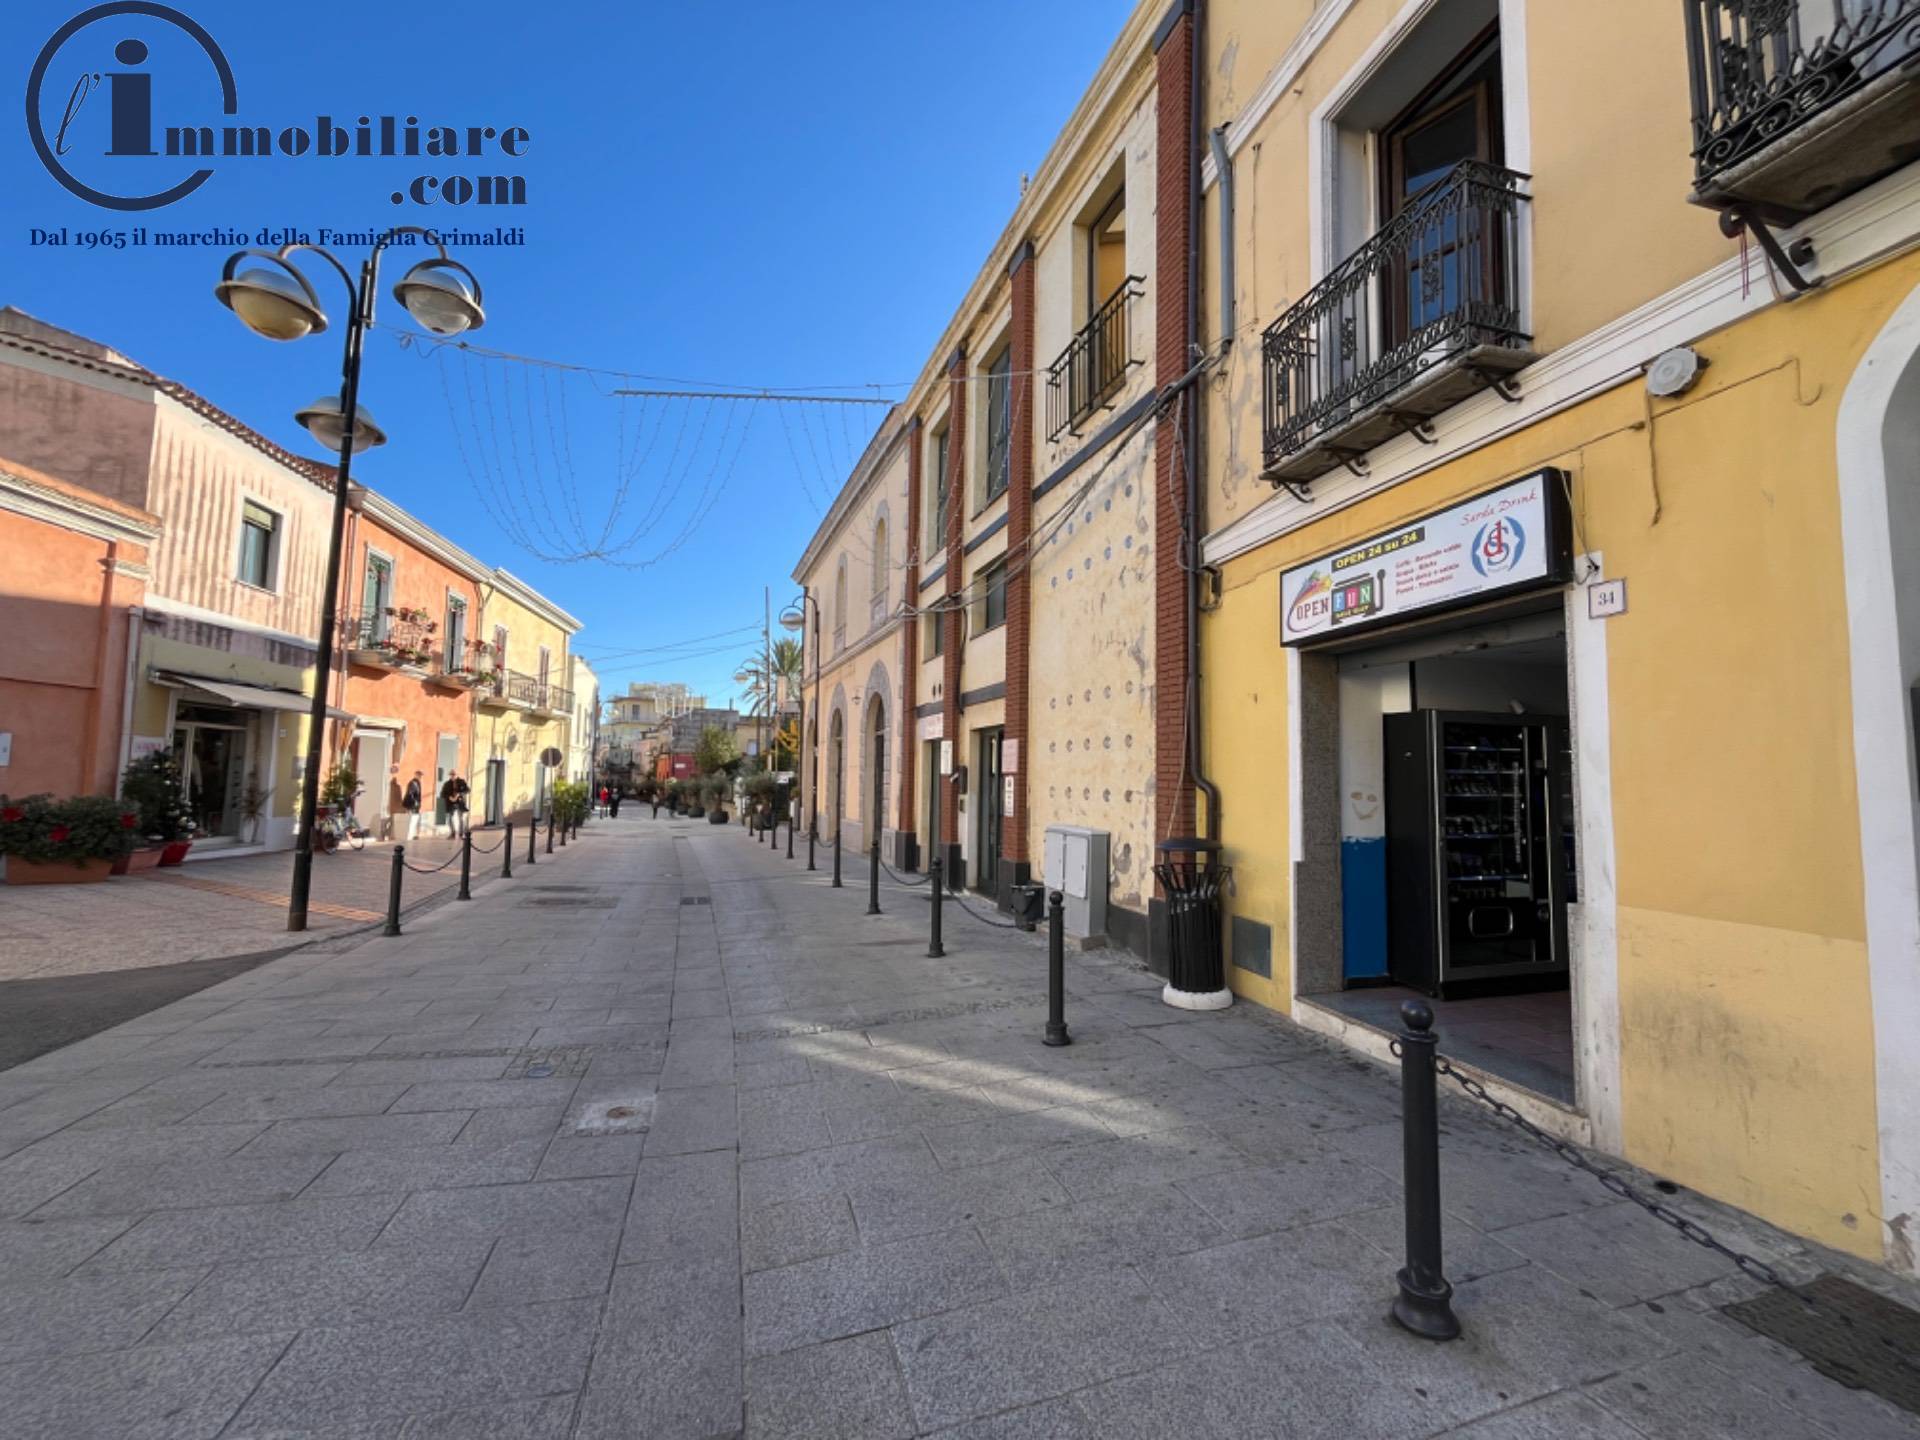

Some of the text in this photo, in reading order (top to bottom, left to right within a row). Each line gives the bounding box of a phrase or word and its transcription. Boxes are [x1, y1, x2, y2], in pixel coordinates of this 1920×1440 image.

[1335, 550, 1366, 569] OPEN
[1368, 543, 1383, 558] 24
[1384, 540, 1400, 551] su
[1401, 531, 1419, 546] 24
[1335, 584, 1372, 608] FUN
[1296, 597, 1330, 621] OPEN
